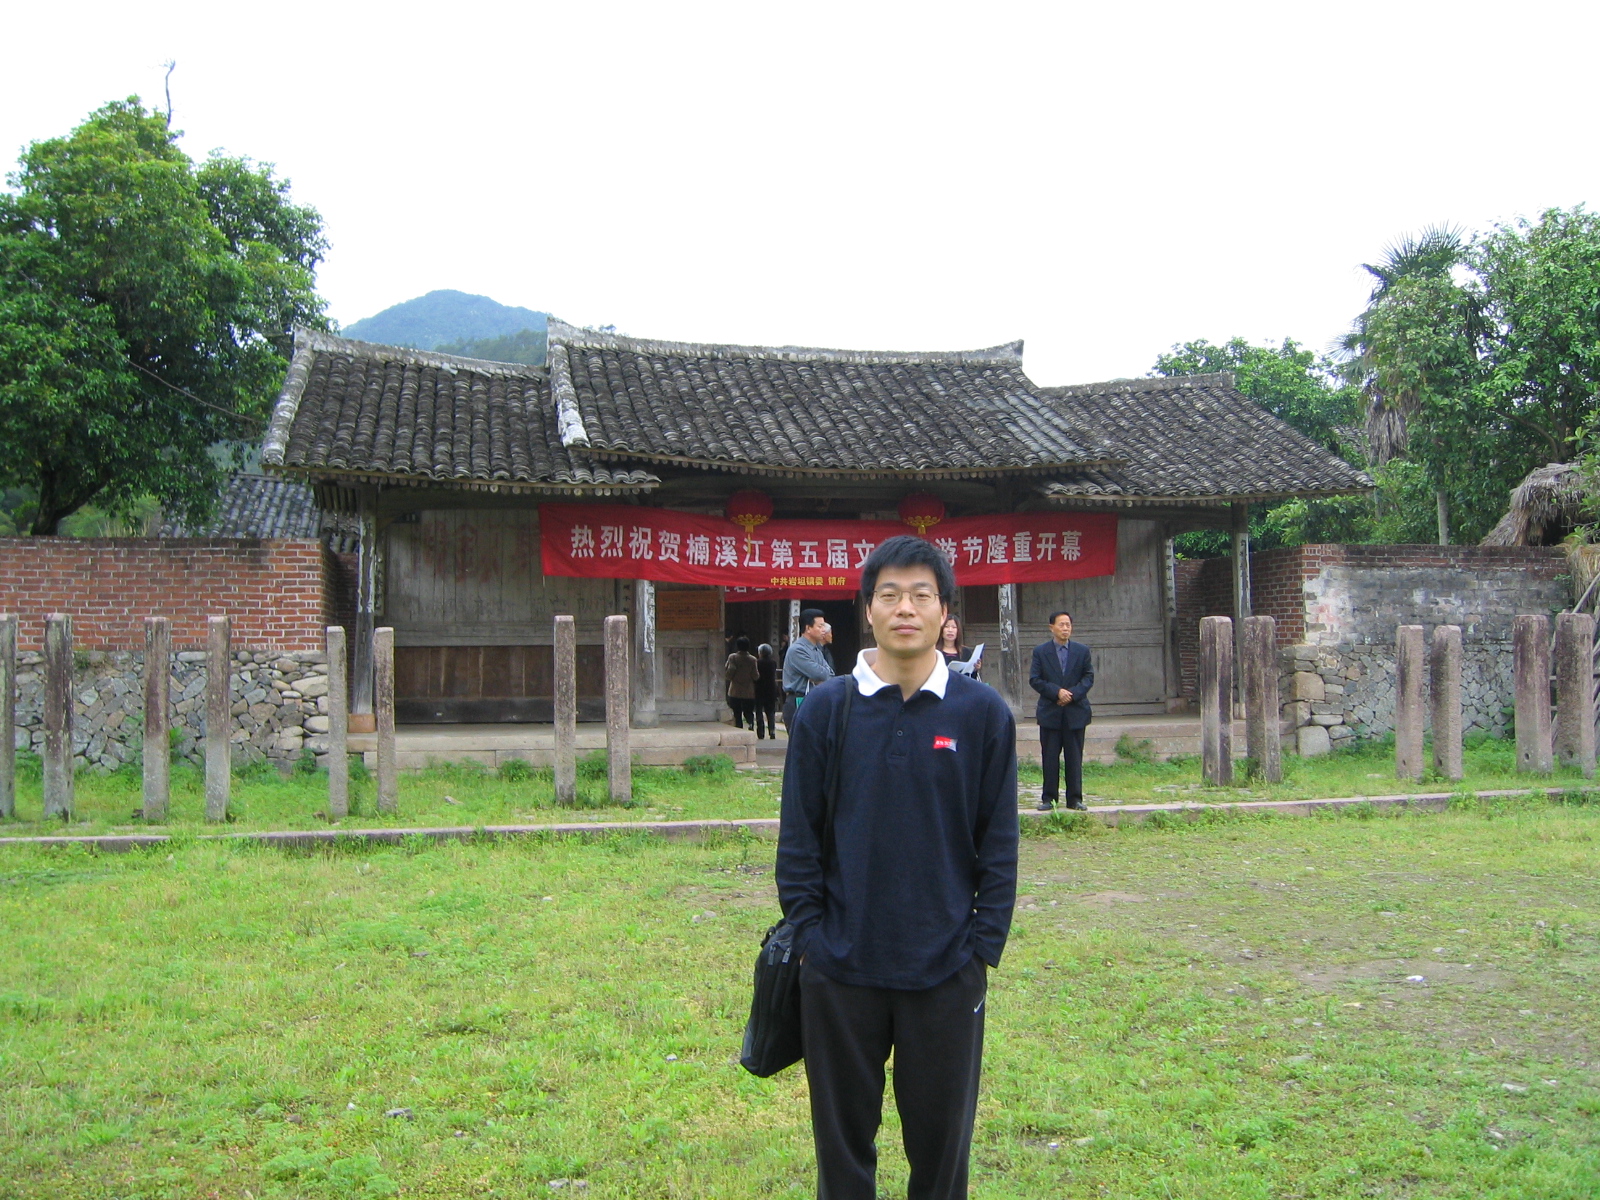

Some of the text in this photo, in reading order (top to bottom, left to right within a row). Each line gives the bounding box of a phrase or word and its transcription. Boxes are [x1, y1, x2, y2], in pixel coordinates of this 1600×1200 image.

[570, 524, 1082, 569] 热烈祝贺楠溪江第五届文游节隆重开幕
[770, 576, 846, 586] 中共岩坦镇委 镇府
